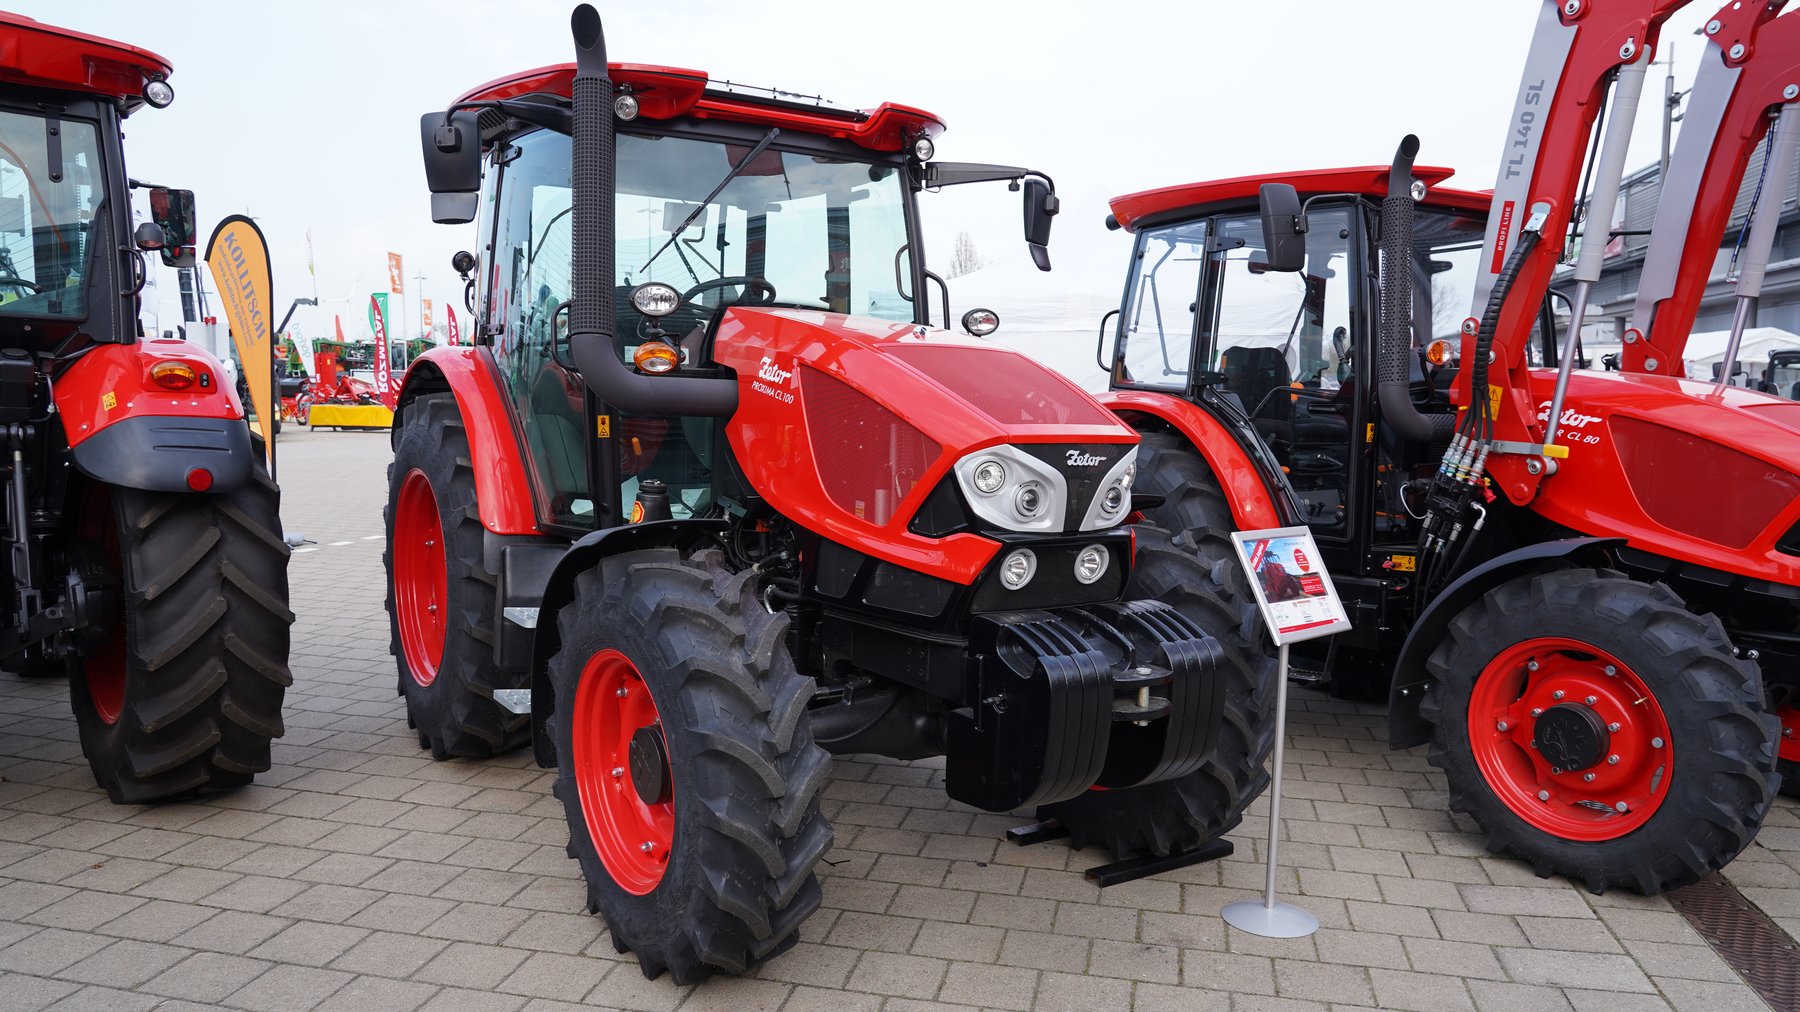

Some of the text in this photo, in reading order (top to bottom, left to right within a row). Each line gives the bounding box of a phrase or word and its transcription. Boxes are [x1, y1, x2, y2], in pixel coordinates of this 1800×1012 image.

[1505, 79, 1545, 180] TL 140 SL
[1497, 206, 1511, 251] PROFI LINE
[223, 231, 266, 340] KOLLITSCH
[758, 356, 792, 384] Zetor
[751, 380, 794, 404] PROXIMA CL 100
[1537, 400, 1602, 428] Ztor
[1567, 431, 1581, 441] CL
[1583, 435, 1600, 444] 80
[1066, 450, 1107, 466] Zetor
